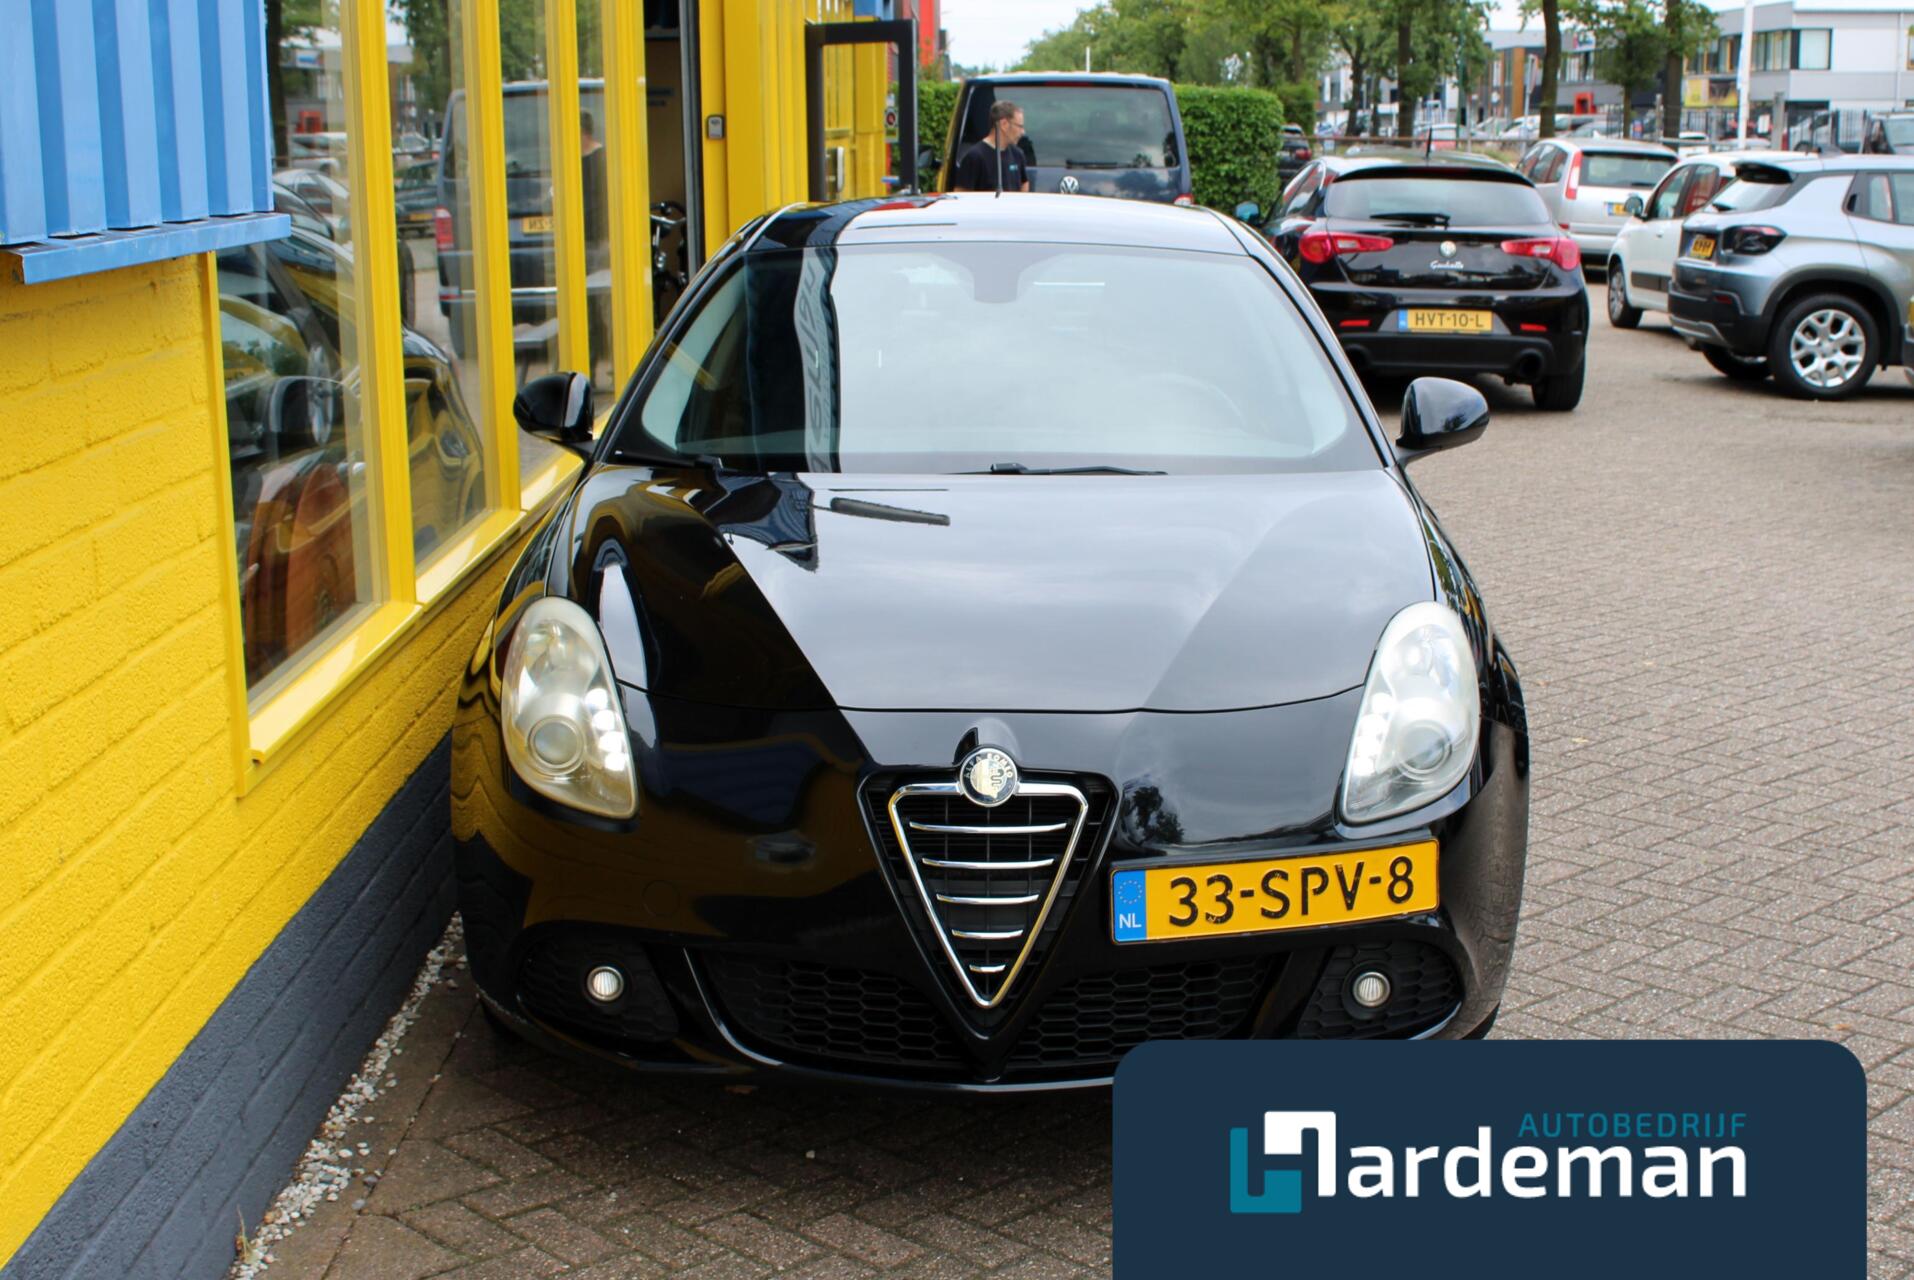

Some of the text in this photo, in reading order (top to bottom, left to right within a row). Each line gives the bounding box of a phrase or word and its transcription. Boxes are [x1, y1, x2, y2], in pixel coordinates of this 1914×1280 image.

[1415, 312, 1484, 328] HVT-10-L
[986, 752, 1013, 778] ROMEO
[1168, 855, 1415, 928] 33-SPV-8
[1118, 912, 1142, 929] NL
